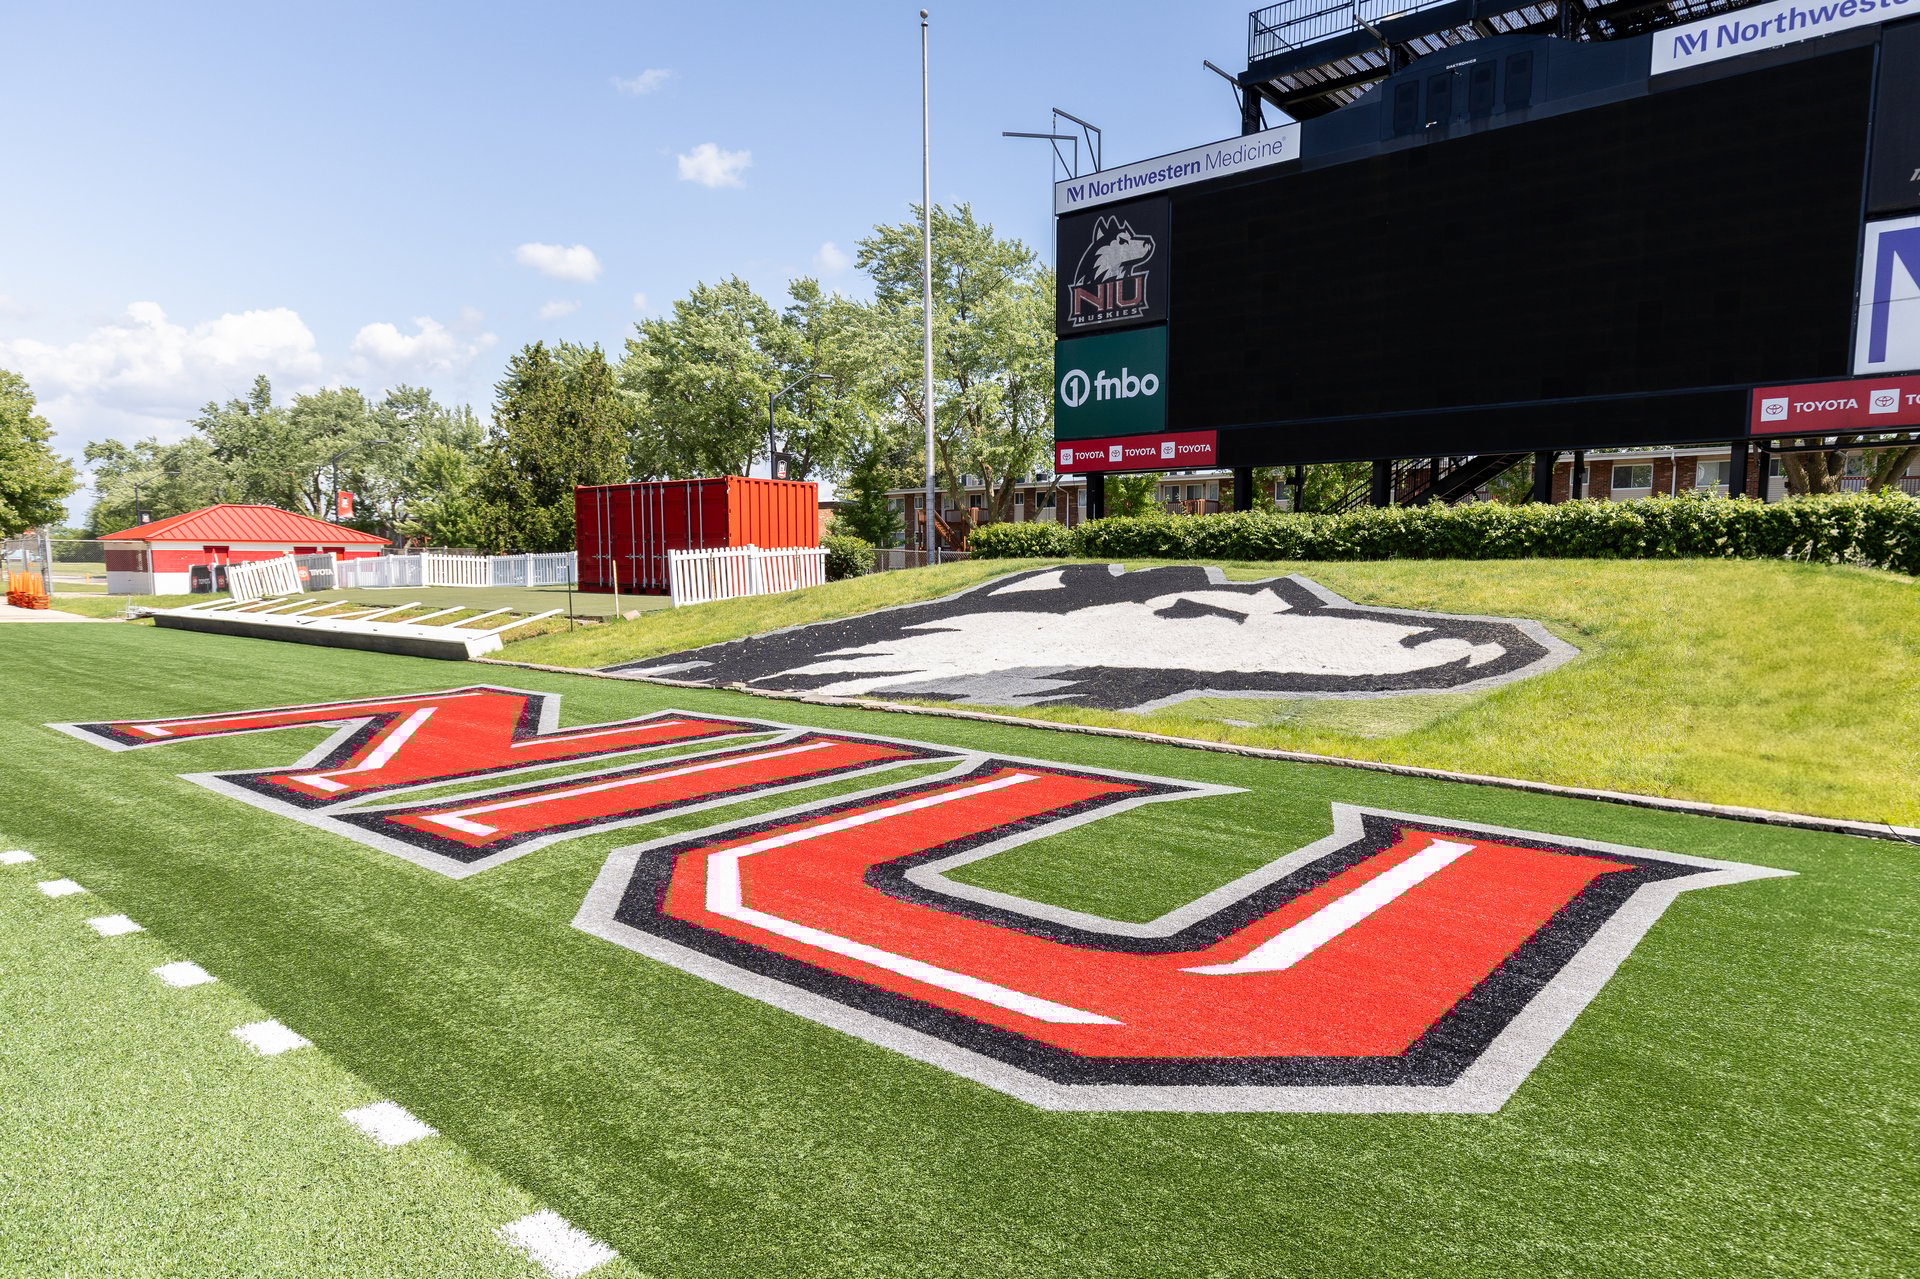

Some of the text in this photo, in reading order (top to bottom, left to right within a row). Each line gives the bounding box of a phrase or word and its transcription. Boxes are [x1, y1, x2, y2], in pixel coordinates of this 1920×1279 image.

[1716, 0, 1909, 48] Northwes
[1088, 160, 1201, 199] Northwestern
[1074, 276, 1143, 315] NIU
[1078, 307, 1138, 323] HUSKIES
[1094, 367, 1160, 401] fnbo
[1793, 398, 1858, 413] TOYOTA
[1075, 444, 1211, 460] TOYOTA TOYOTA TOYOTA
[50, 686, 1790, 1110] NIU
